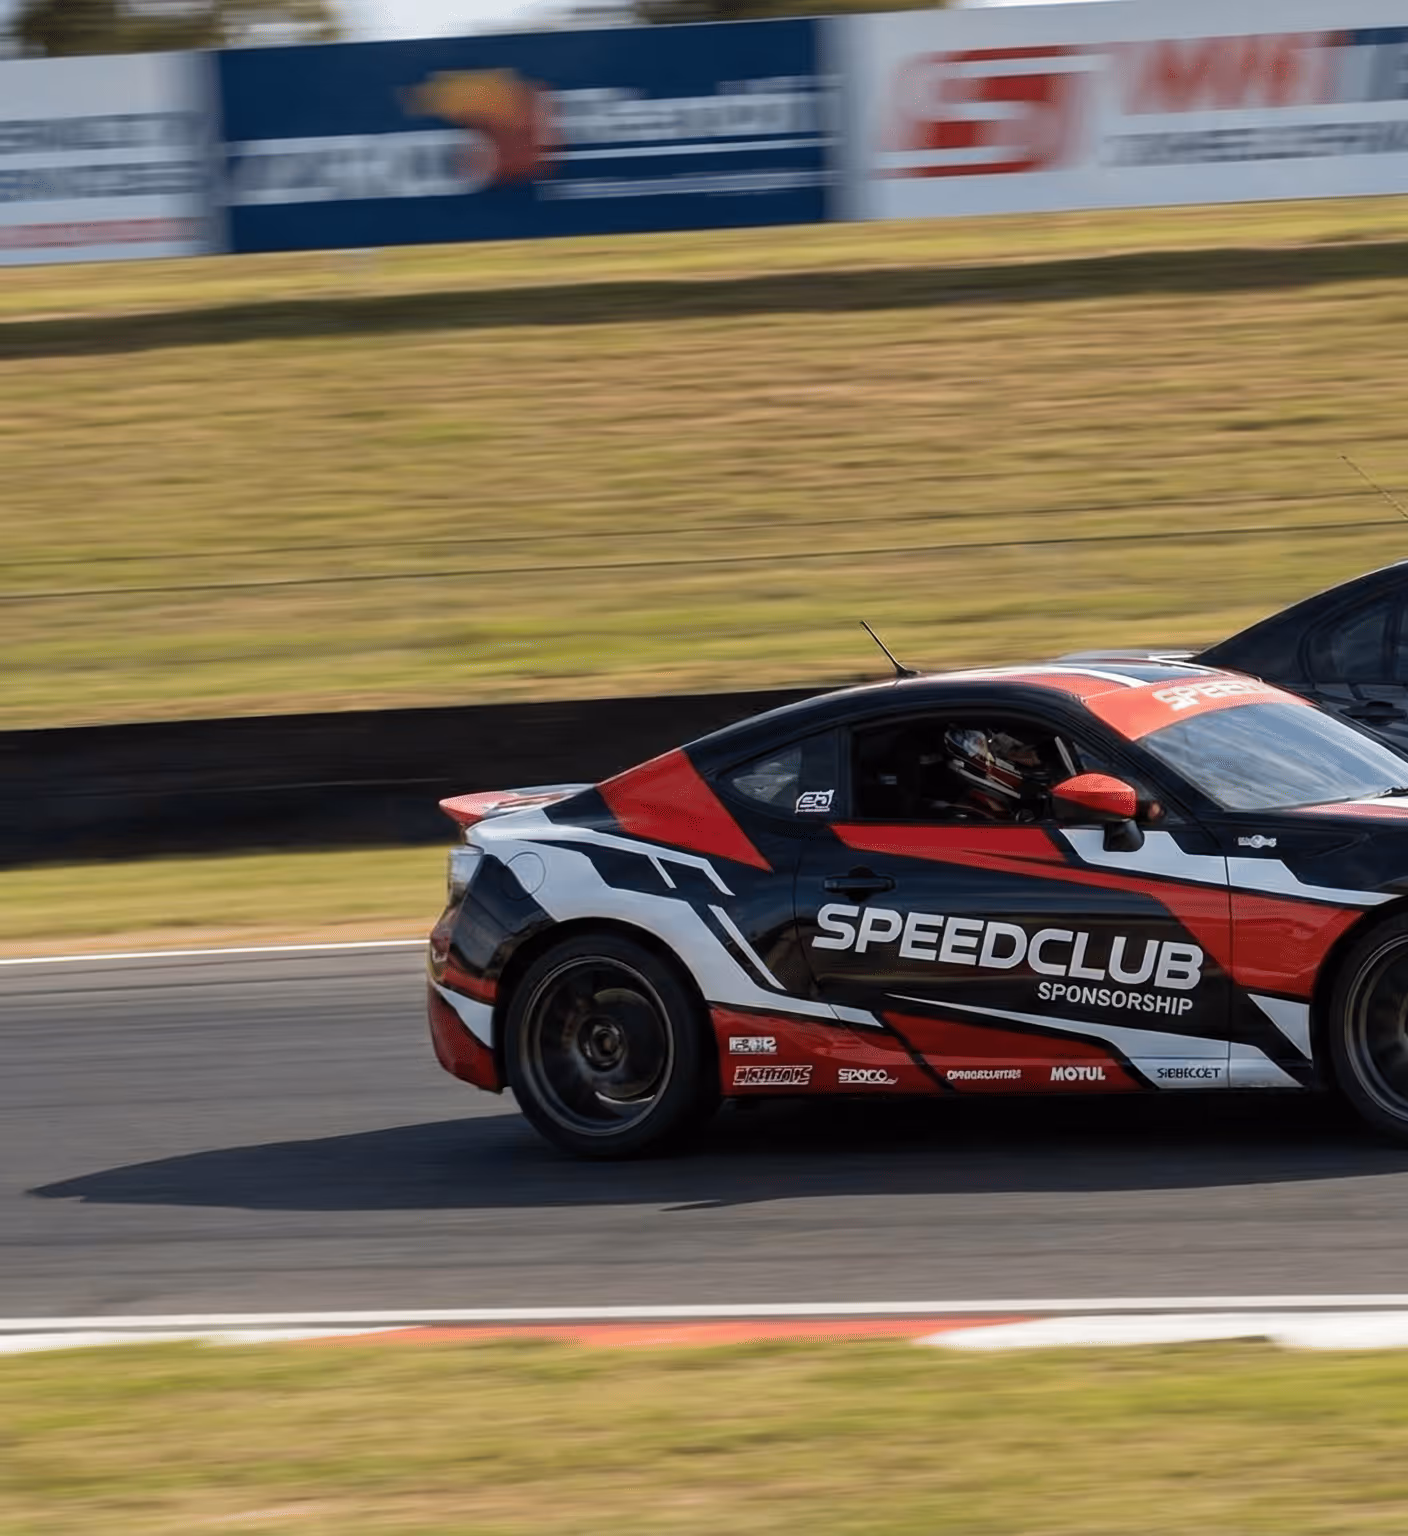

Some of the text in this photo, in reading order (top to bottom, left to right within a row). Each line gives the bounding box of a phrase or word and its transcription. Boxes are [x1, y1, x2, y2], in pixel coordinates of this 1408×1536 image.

[811, 903, 1204, 990] SPEEDCLUB
[1037, 981, 1194, 1016] SPONSORSHIP
[1050, 1066, 1106, 1081] MOTUL
